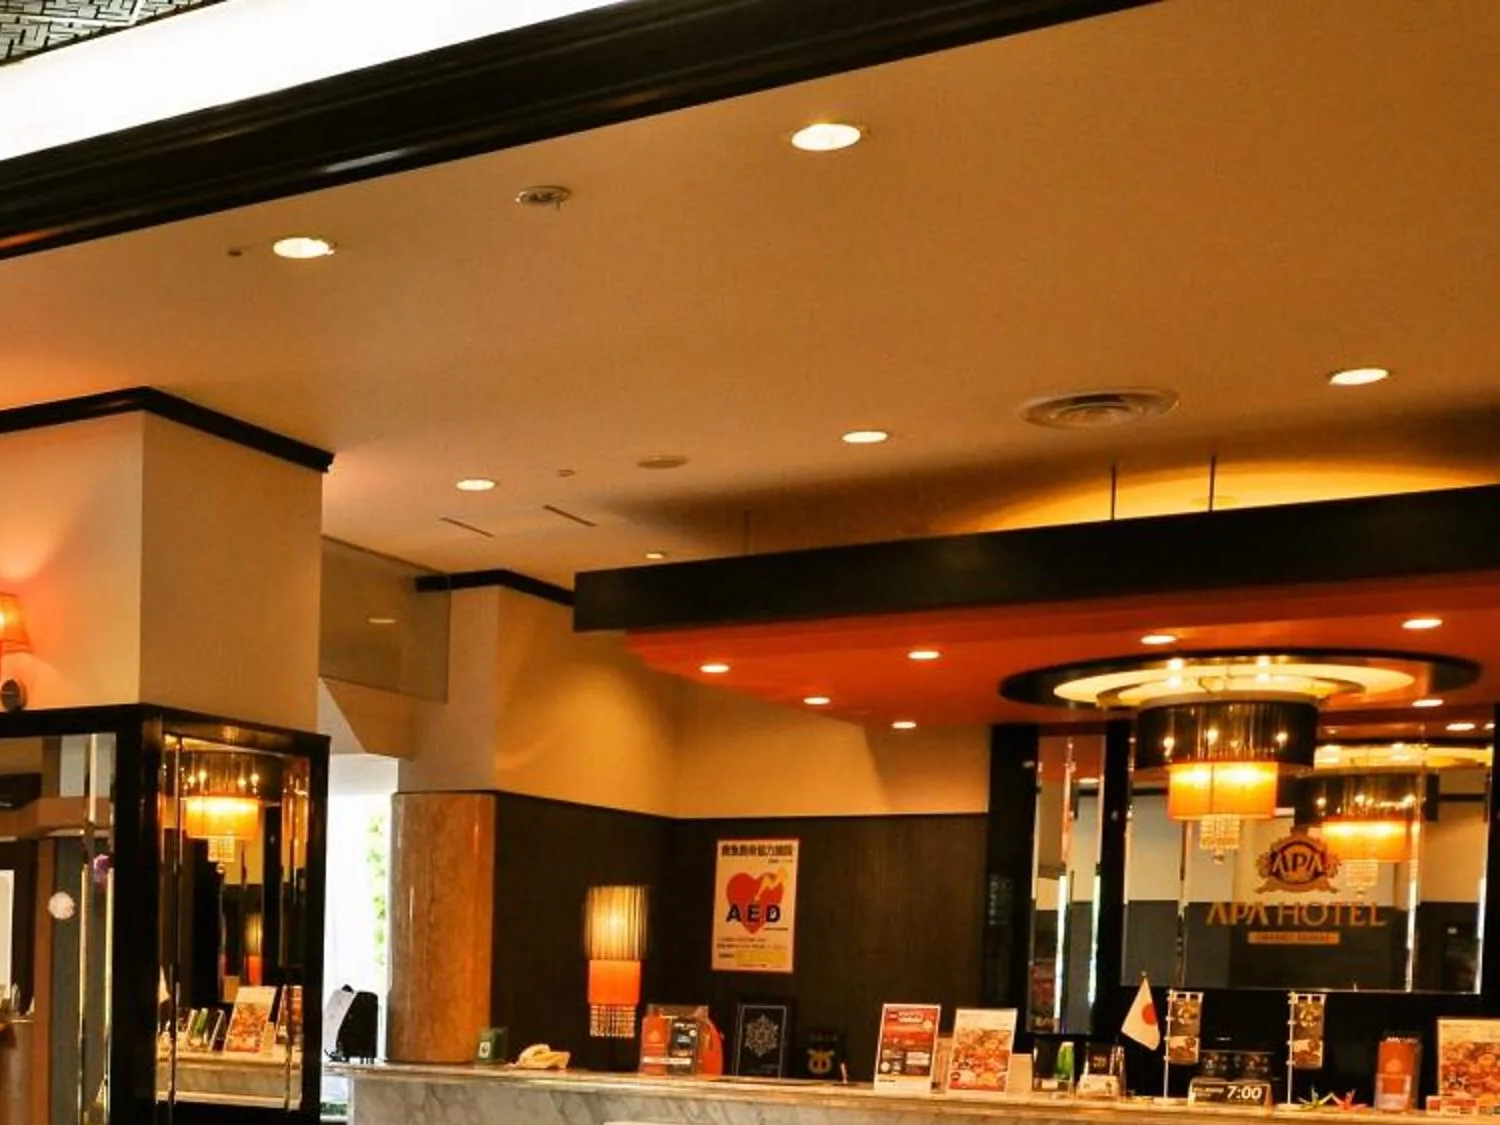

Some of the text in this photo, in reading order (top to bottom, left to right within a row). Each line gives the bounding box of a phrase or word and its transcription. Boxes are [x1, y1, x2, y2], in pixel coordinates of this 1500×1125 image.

[1272, 852, 1323, 873] APA
[725, 903, 781, 923] AED
[1206, 900, 1388, 926] APA HOTEL
[1227, 1085, 1263, 1099] 7:00
